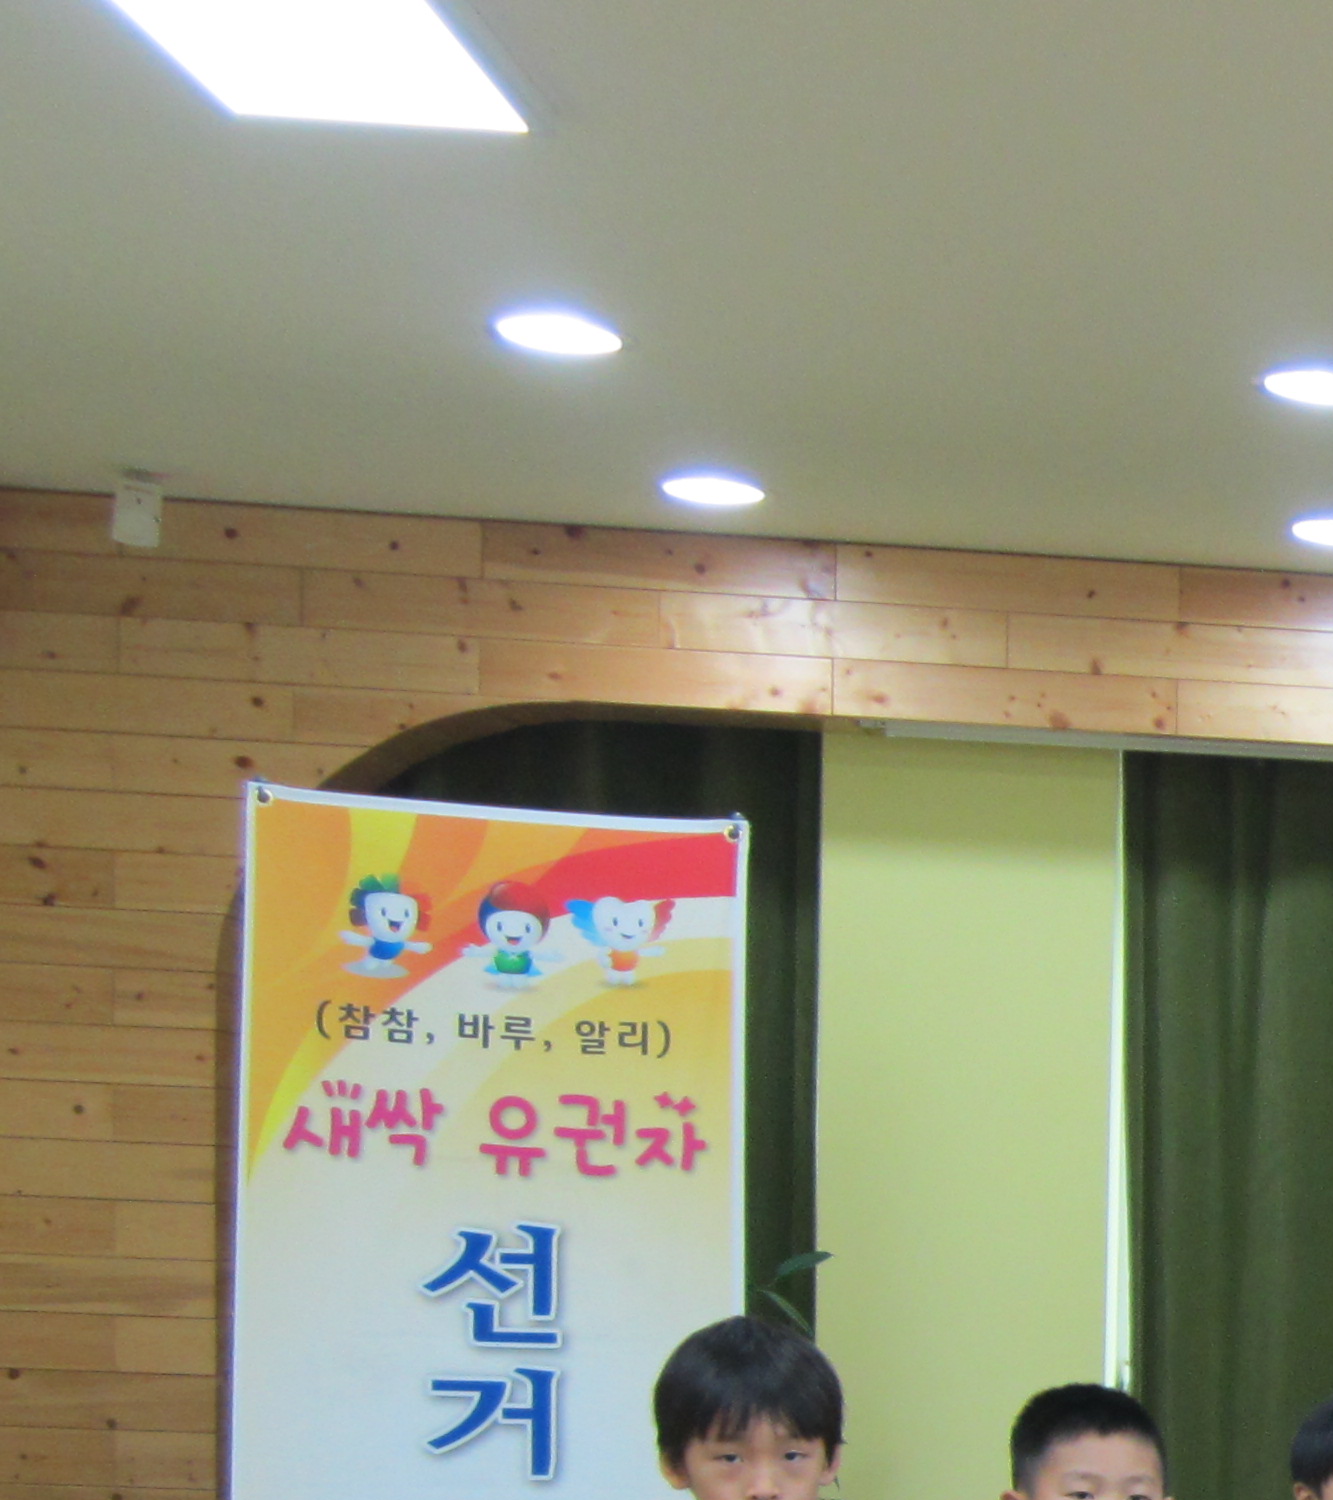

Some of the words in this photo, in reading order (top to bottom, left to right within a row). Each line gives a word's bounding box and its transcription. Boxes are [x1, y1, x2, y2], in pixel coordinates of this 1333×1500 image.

[315, 1000, 435, 1045] (참참,
[457, 1012, 552, 1052] 바루,
[574, 1018, 672, 1058] 알리)
[282, 1079, 445, 1167] 새싹
[479, 1091, 708, 1177] 유권자
